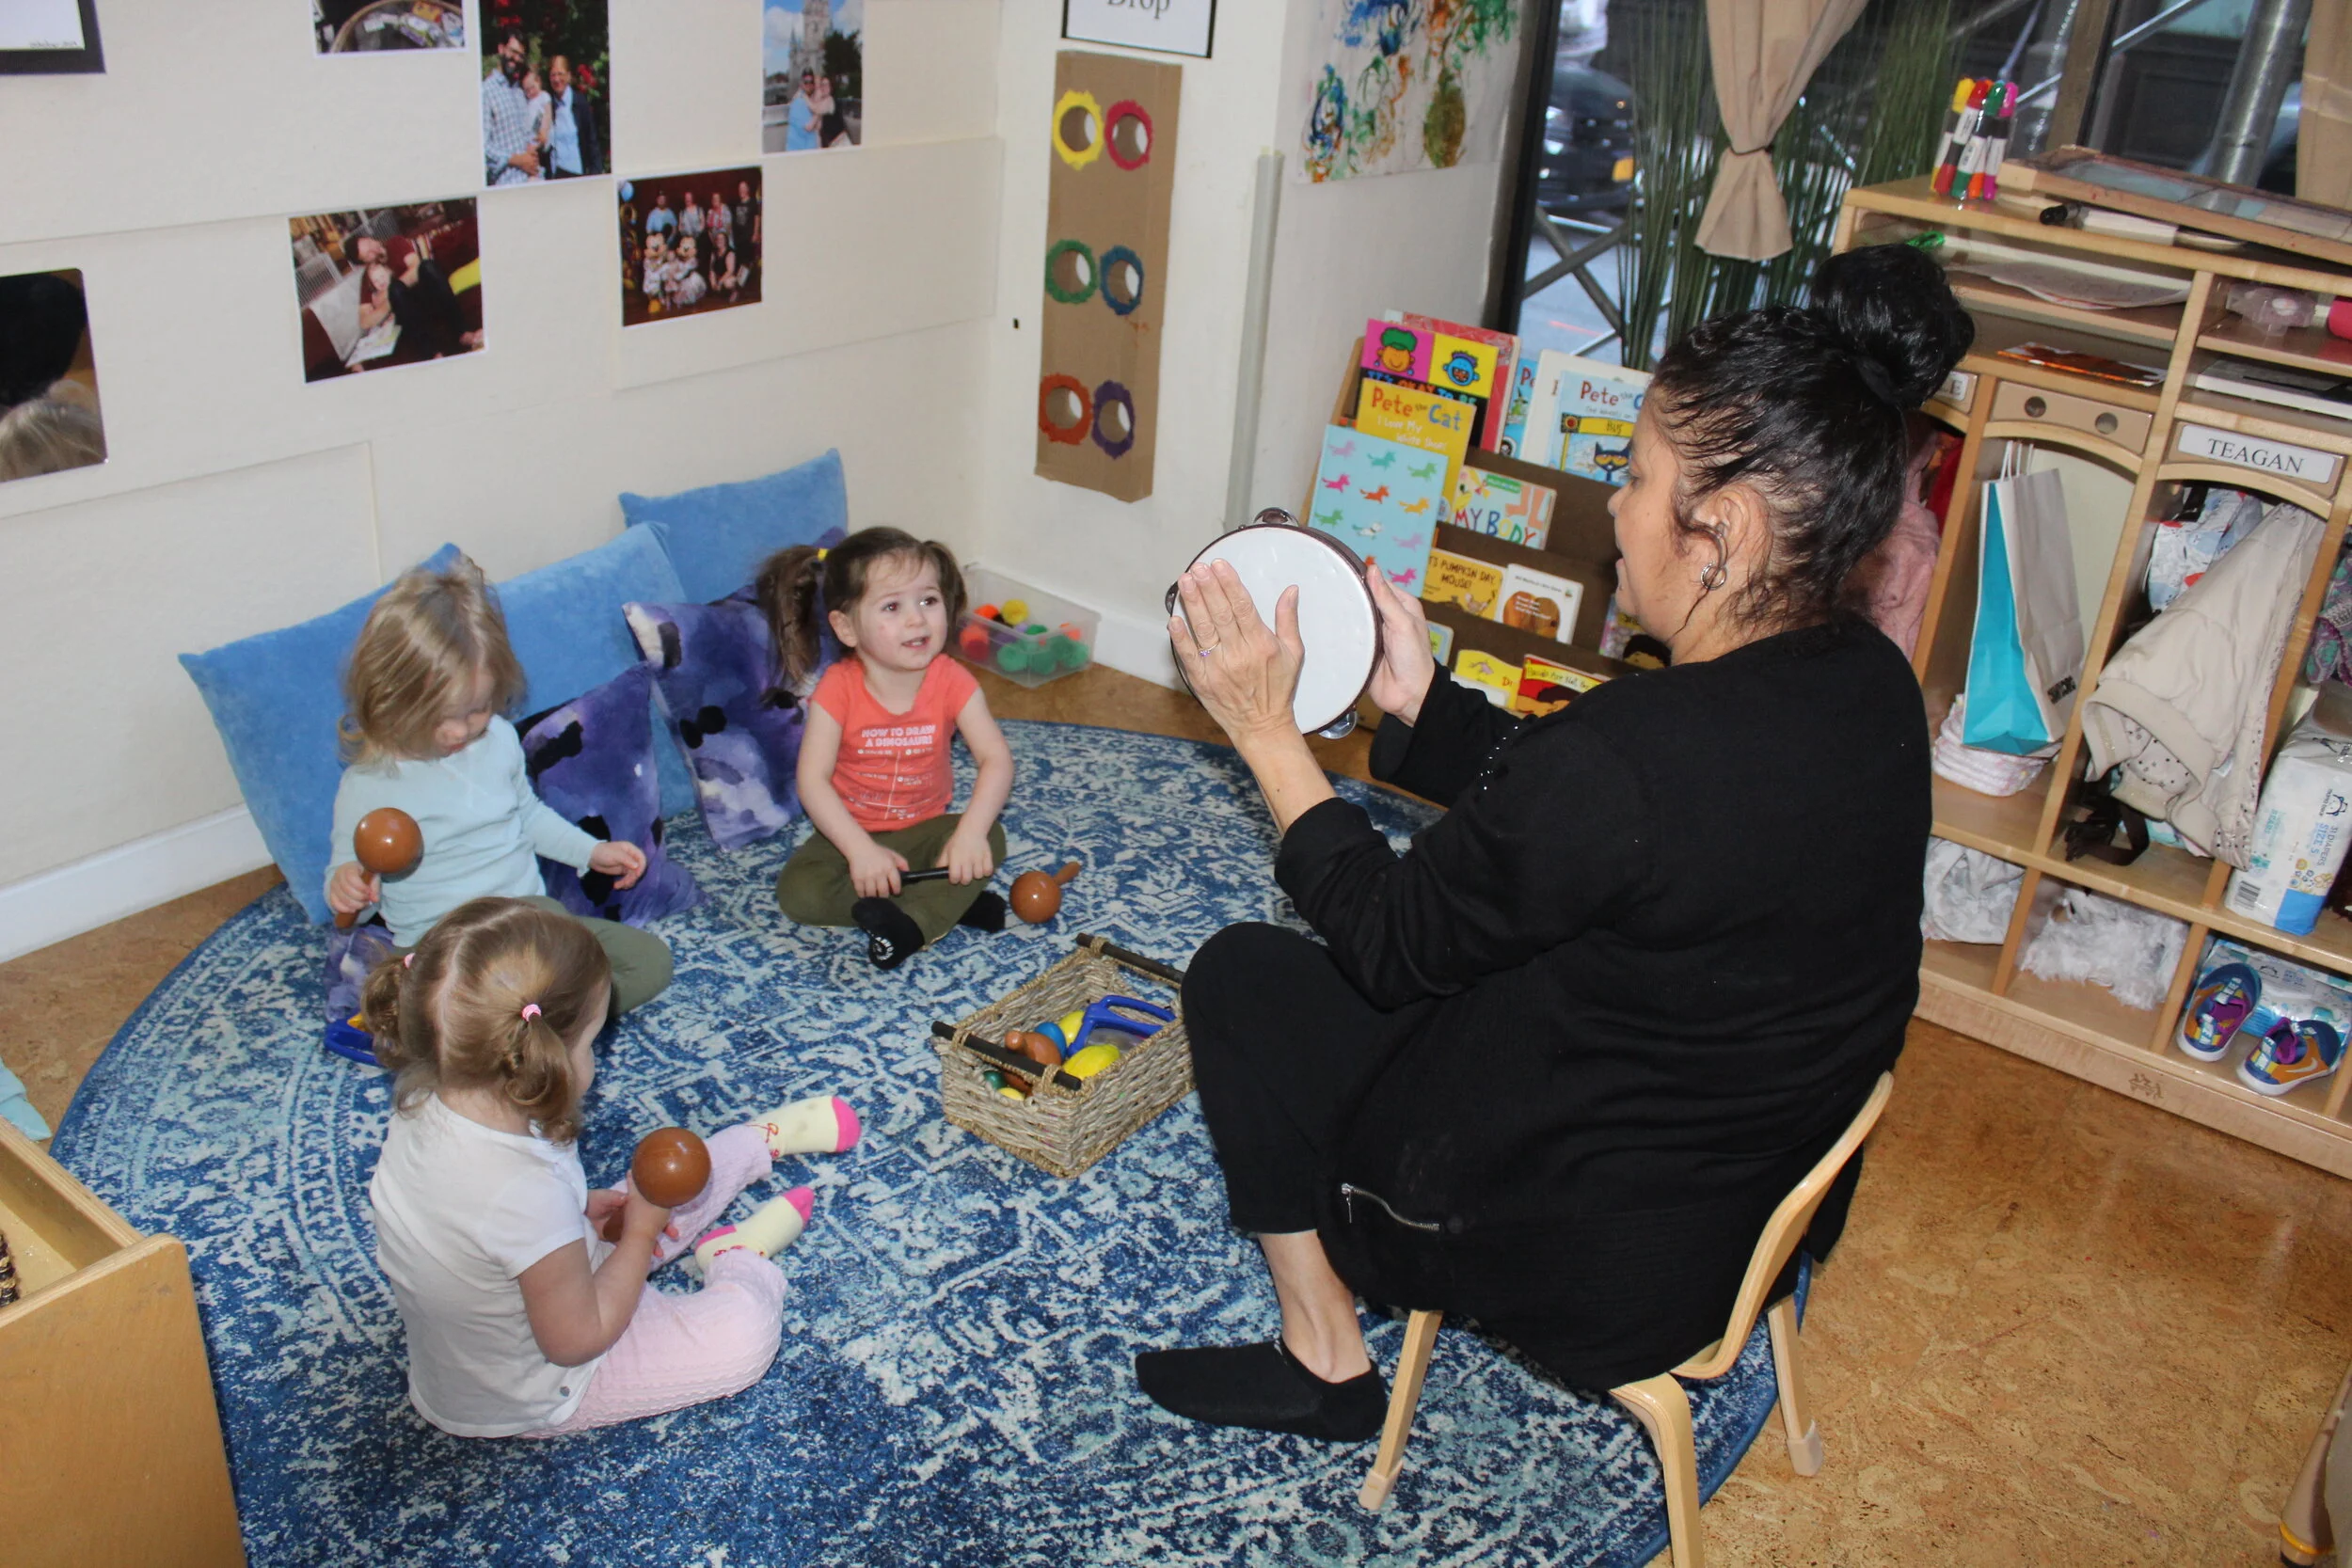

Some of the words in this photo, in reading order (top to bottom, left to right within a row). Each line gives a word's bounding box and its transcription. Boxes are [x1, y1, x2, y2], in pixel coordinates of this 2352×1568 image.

[1107, 0, 1170, 20] rop
[1581, 380, 1619, 406] Pete
[1372, 386, 1413, 418] Pete
[1428, 404, 1461, 432] Cat
[2208, 437, 2305, 474] TEAGAN
[1454, 508, 1484, 532] MY
[1486, 511, 1536, 546] BODY
[861, 728, 888, 738] HOW
[890, 727, 904, 737] TO
[905, 724, 936, 736] DRAW
[866, 738, 874, 748] A
[2313, 823, 2329, 846] SIZE
[2316, 834, 2336, 866] DIAPERS
